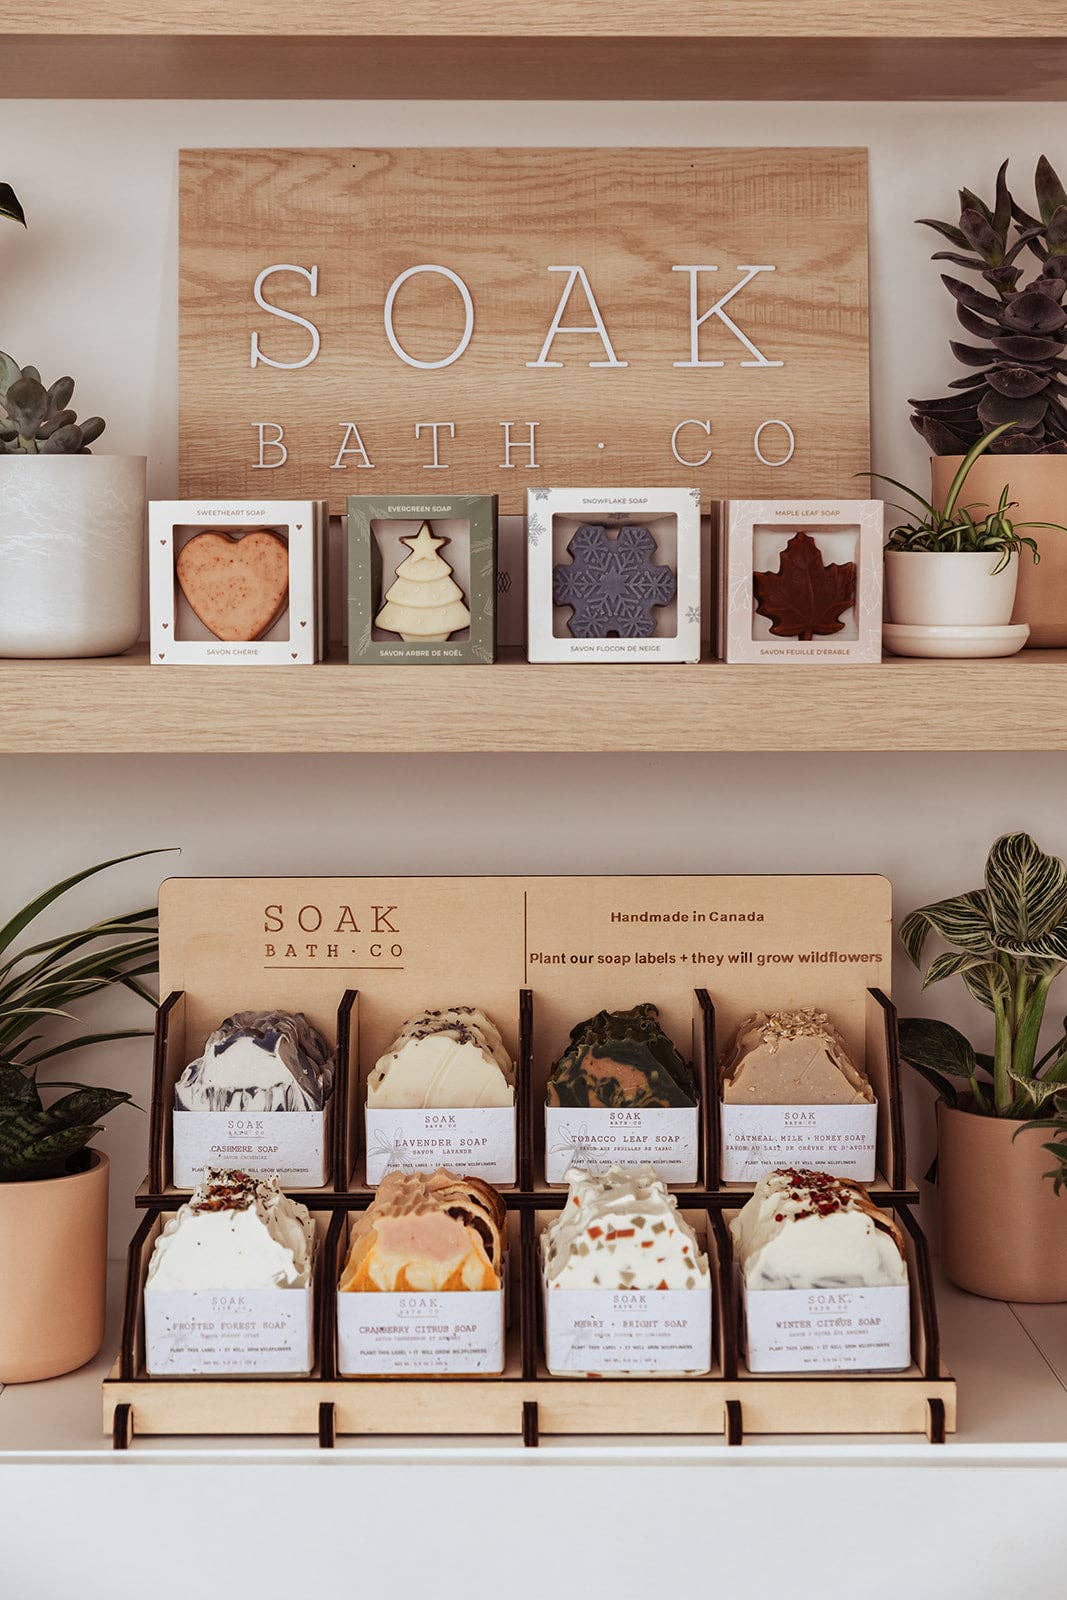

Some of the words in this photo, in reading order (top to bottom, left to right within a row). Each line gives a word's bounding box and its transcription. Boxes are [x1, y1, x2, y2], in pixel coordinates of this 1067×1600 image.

[250, 264, 784, 370] SOAK
[251, 422, 540, 469] BATH
[443, 649, 463, 657] NOËL
[264, 905, 400, 933] SOAK
[611, 912, 689, 923] Handmade
[693, 911, 706, 923] in
[709, 911, 765, 923] Canada
[265, 944, 339, 958] BATH
[529, 953, 566, 964] Plant
[570, 954, 594, 964] our
[597, 955, 631, 966] soap
[635, 952, 676, 964] labels
[680, 954, 688, 963] +
[692, 952, 724, 966] they
[728, 952, 752, 964] will
[757, 954, 794, 966] grow
[798, 951, 883, 963] wildflowers
[425, 1115, 456, 1123] SOAK
[610, 1112, 641, 1120] SOAK
[784, 1112, 816, 1120] SOAK
[228, 1121, 264, 1129] SOAK
[395, 1139, 452, 1147] LAVENDER
[460, 1138, 488, 1146] SOAP
[211, 1145, 253, 1153] CASHMERE
[258, 1145, 279, 1153] SOAP
[211, 1297, 245, 1305] SOAK
[400, 1299, 438, 1308] SOAK
[614, 1295, 647, 1303] SOAK
[808, 1295, 847, 1304] SOAK
[172, 1323, 215, 1331] FROSTED
[221, 1322, 257, 1330] FOREST
[623, 1320, 658, 1328] BRIGHT
[664, 1320, 688, 1328] SOAP
[776, 1320, 812, 1329] WINTER
[816, 1319, 852, 1328] CITRUS
[858, 1318, 882, 1326] SOAP
[359, 1326, 410, 1334] CRANBERRY
[415, 1325, 449, 1333] CITRUS
[454, 1325, 477, 1333] SOAP
